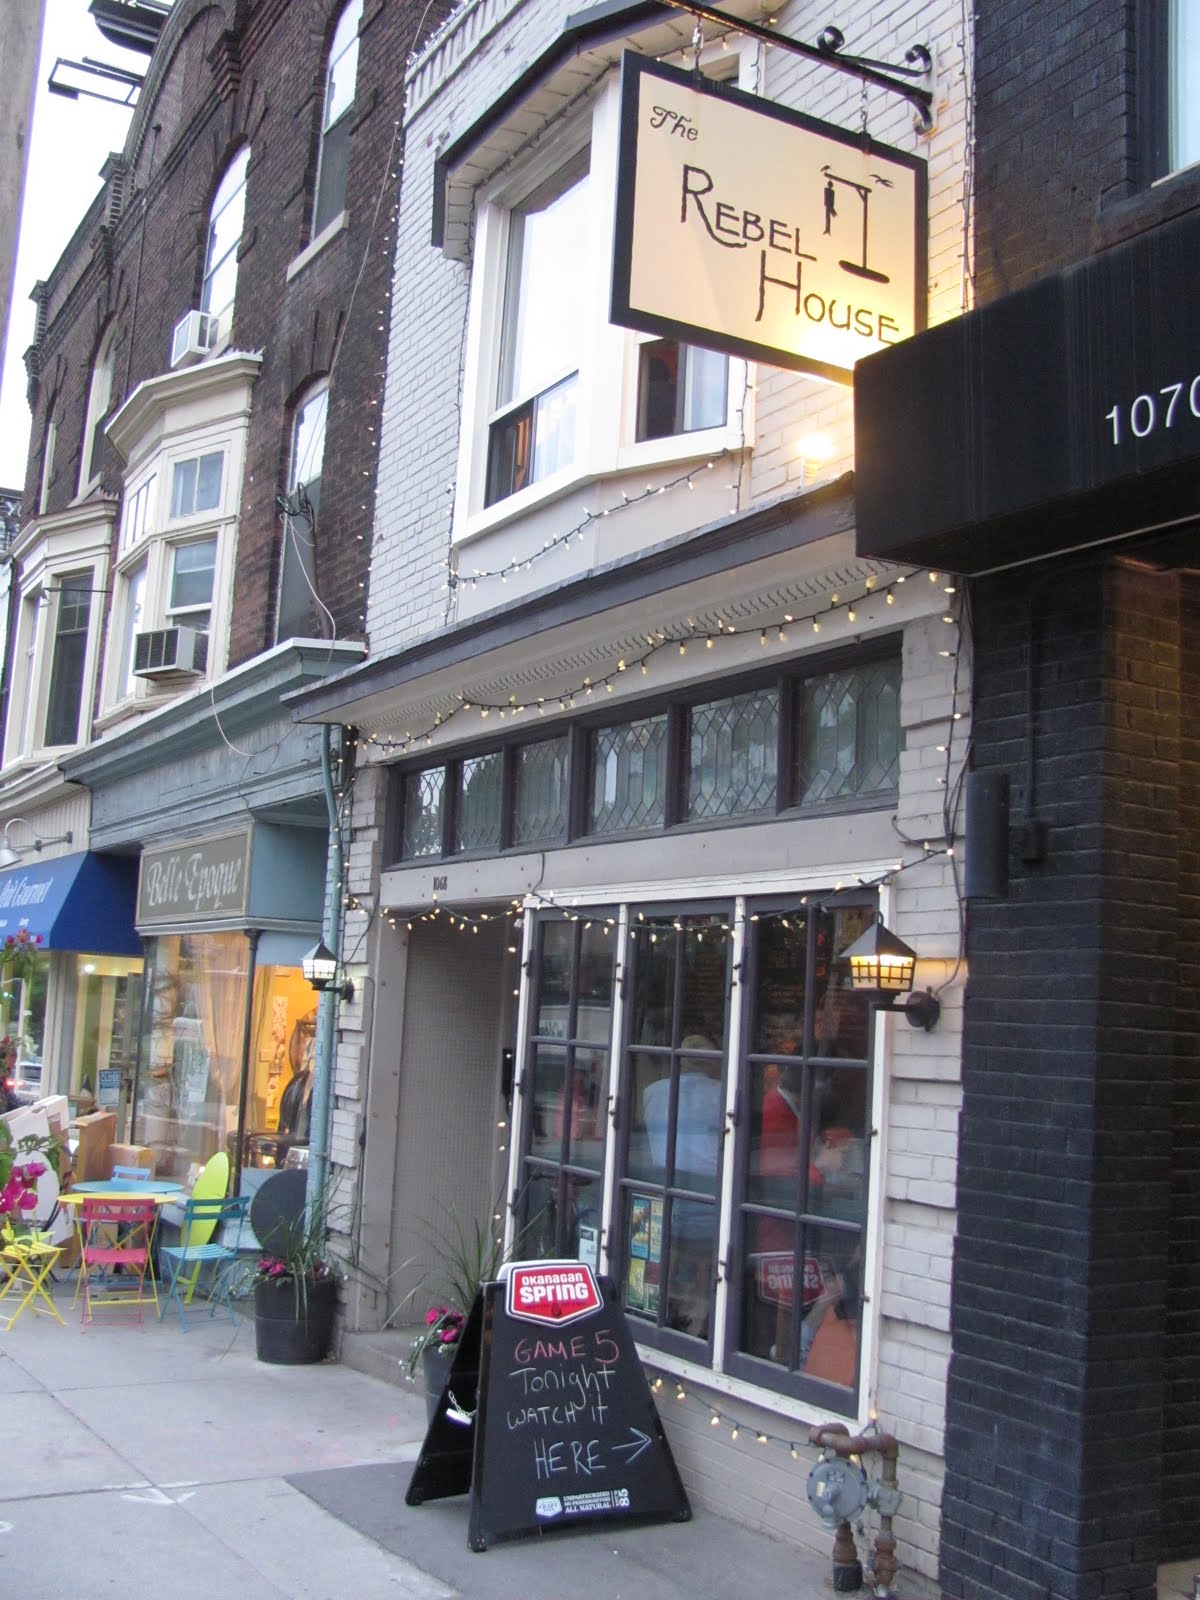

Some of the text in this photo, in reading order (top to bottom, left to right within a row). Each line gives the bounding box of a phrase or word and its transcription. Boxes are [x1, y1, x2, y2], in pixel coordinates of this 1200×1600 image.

[650, 106, 699, 141] The
[681, 164, 817, 261] REBEL
[755, 249, 899, 345] HOUSE
[147, 855, 182, 907] Belle
[514, 1329, 619, 1363] GAME 5
[508, 1363, 616, 1409] Tonight
[507, 1401, 577, 1430] WATCH
[534, 1438, 607, 1479] HERE
[565, 1505, 579, 1513] ALL
[579, 1502, 612, 1511] NATURAL
